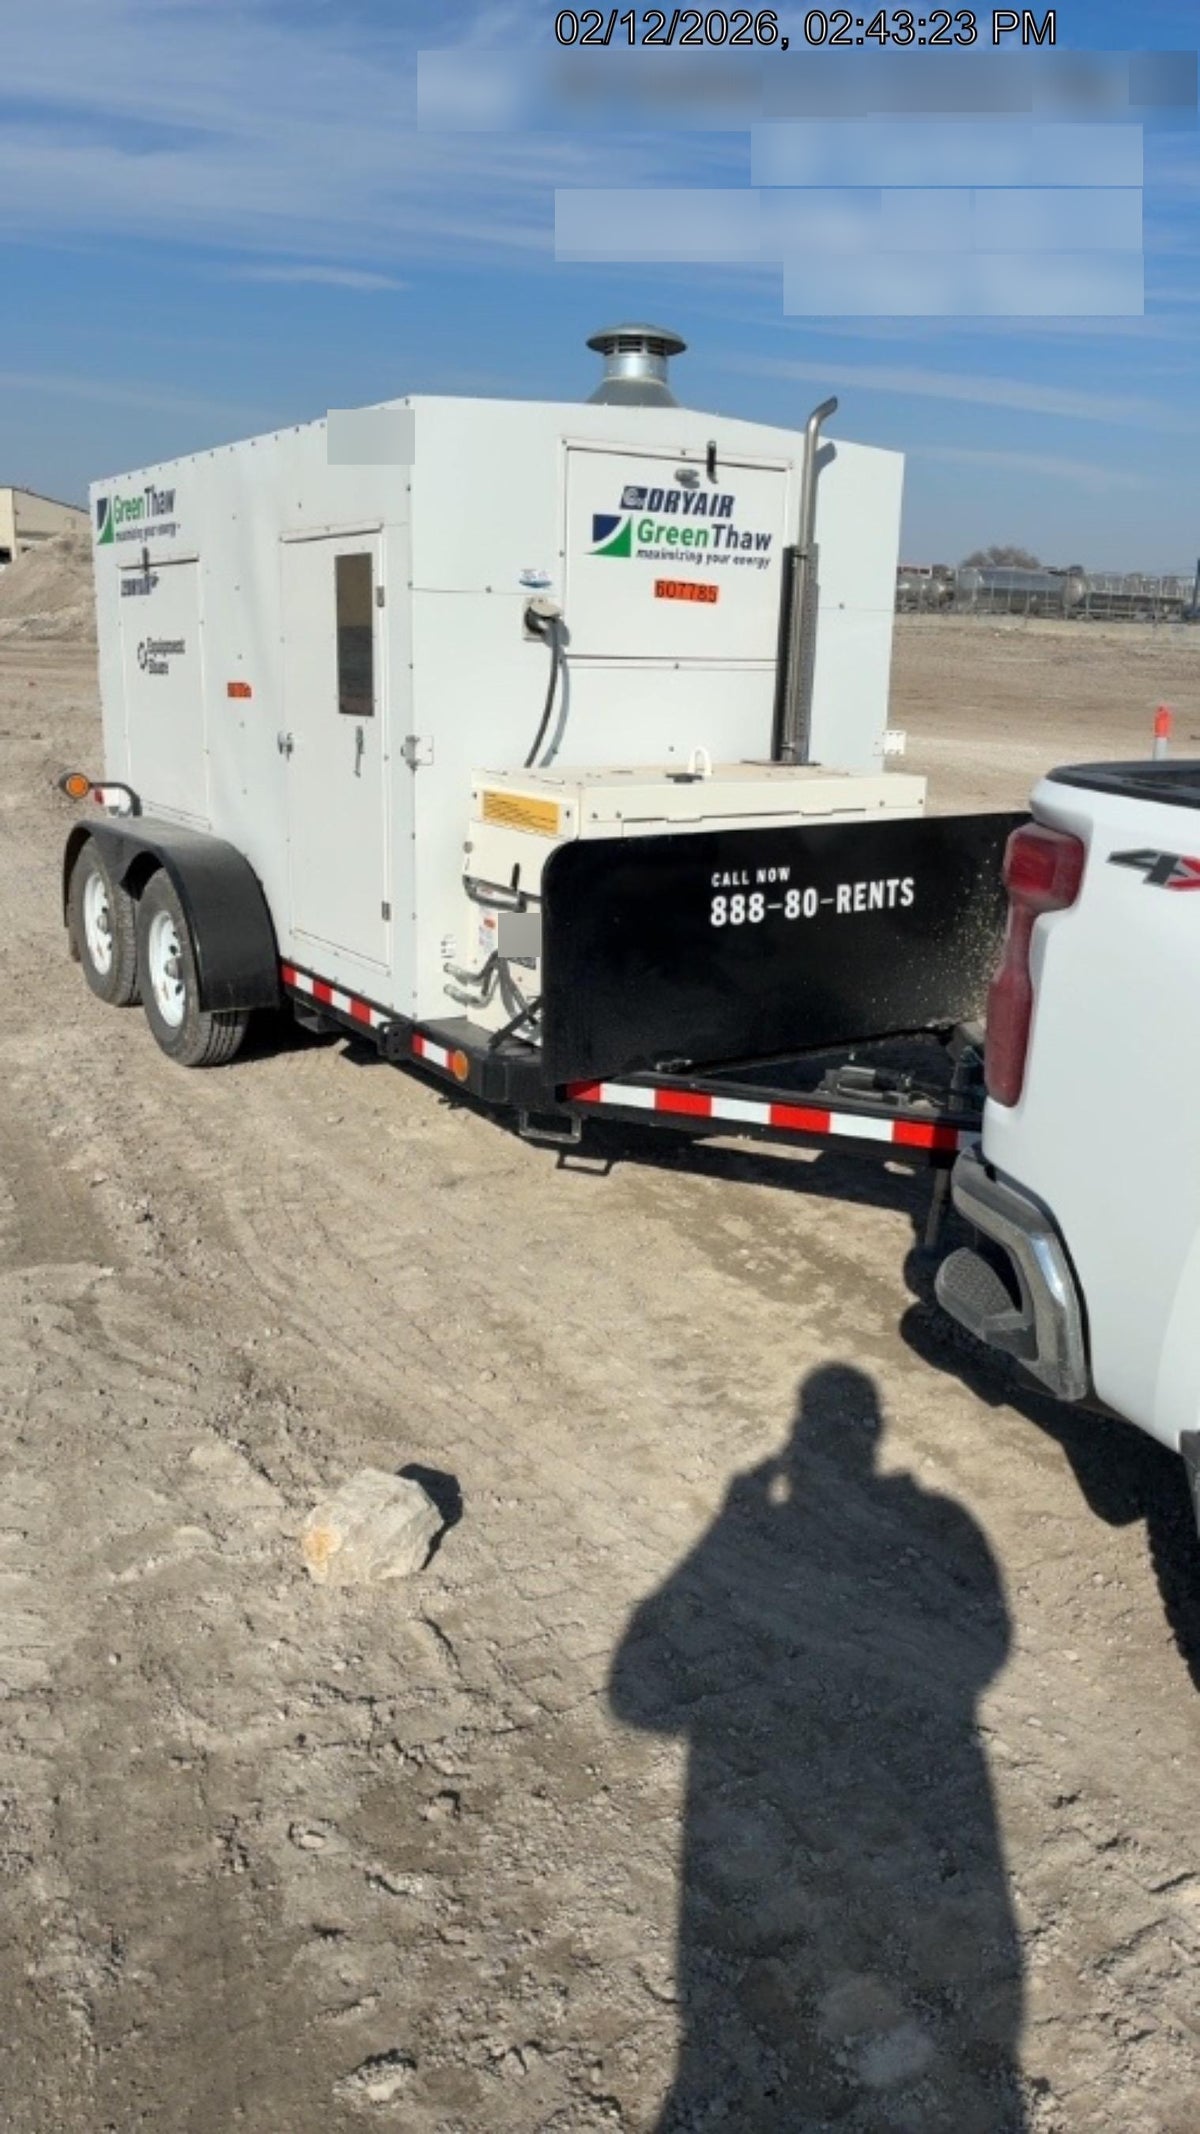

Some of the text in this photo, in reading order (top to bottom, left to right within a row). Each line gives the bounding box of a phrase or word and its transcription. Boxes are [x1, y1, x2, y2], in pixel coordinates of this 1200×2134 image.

[647, 487, 735, 518] DRYAIR
[637, 518, 772, 551] GreenThaw
[635, 548, 772, 569] maximizing your energy
[654, 580, 718, 603] 607785
[711, 867, 790, 888] CALL NOW
[710, 877, 915, 927] 888-80-RENTS
